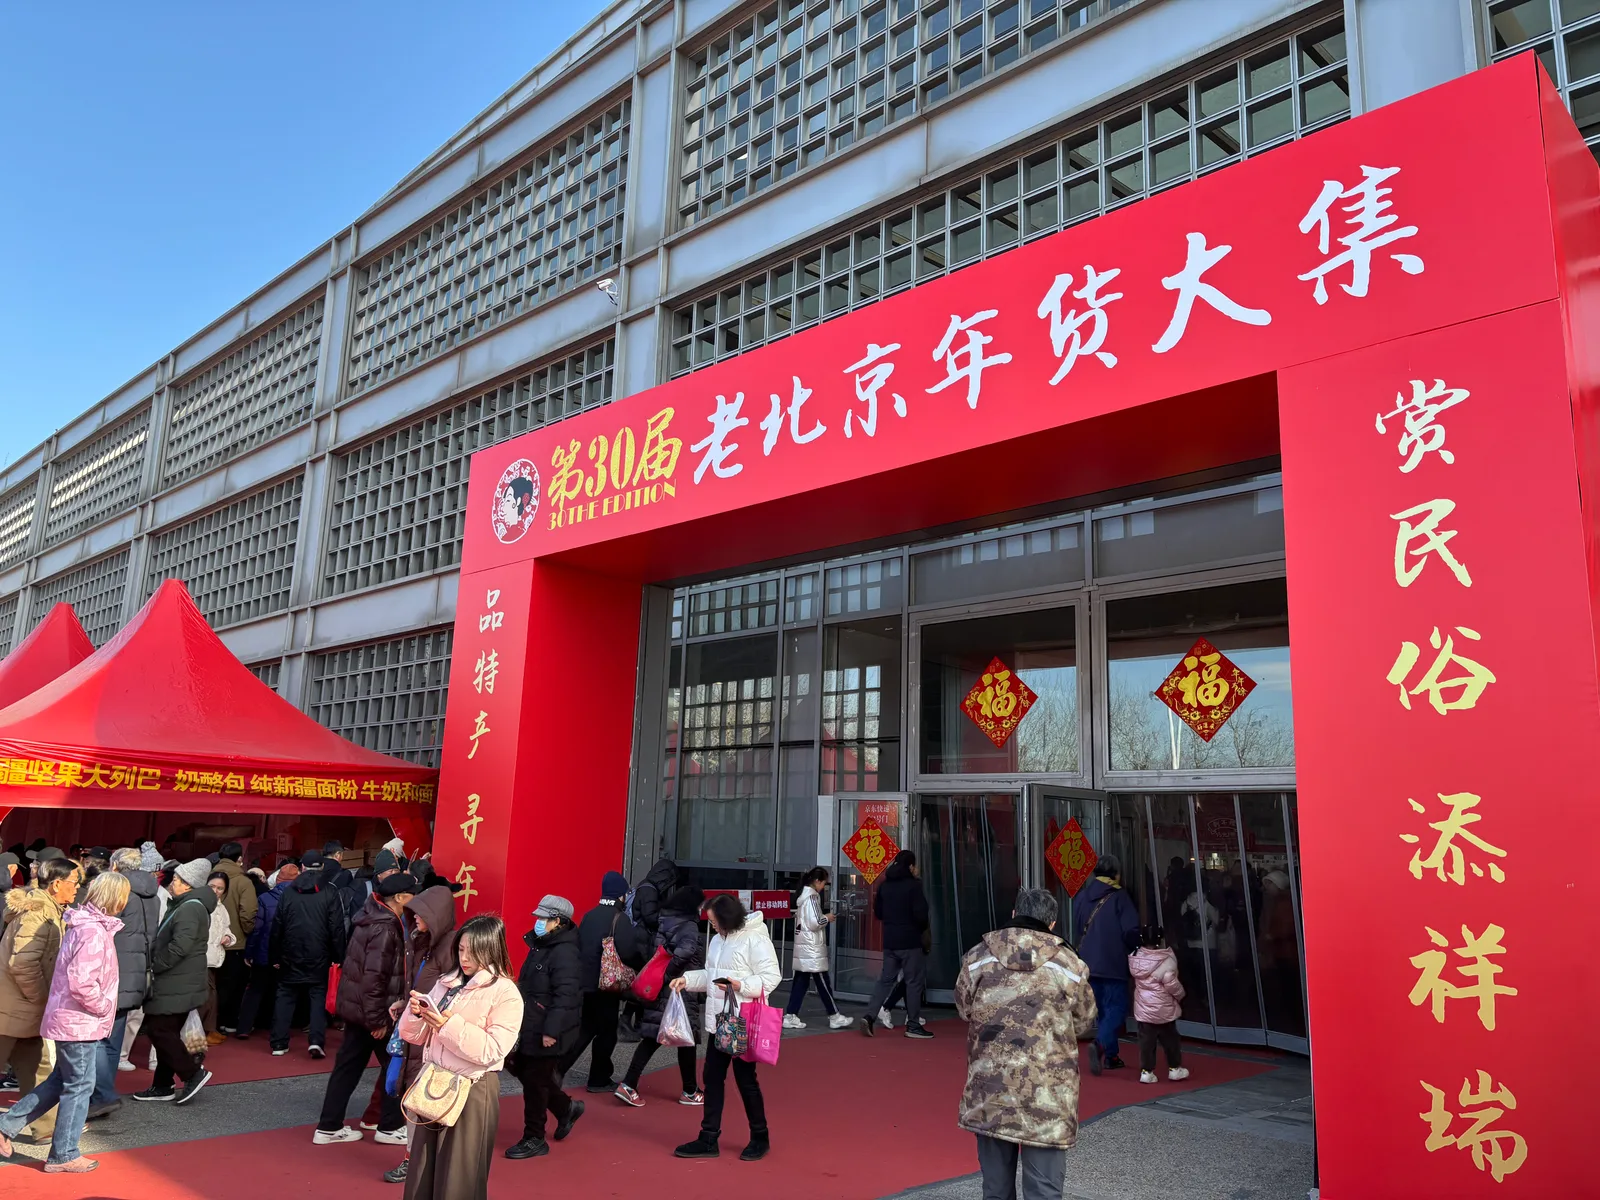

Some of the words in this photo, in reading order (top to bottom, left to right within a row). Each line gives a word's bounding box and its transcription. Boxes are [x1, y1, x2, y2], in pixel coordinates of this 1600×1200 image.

[548, 407, 682, 509] 第30届
[689, 165, 1425, 484] 老北京年货大集
[602, 478, 677, 516] EDITION
[1375, 379, 1496, 715] 赏民俗
[468, 589, 504, 759] 品特产
[977, 670, 1017, 718] 福
[1178, 652, 1229, 708] 福
[173, 769, 245, 794] 奶酪包
[250, 774, 359, 800] 纯新疆面粉
[453, 794, 484, 913] 寻年
[855, 829, 885, 864] 福
[1059, 830, 1085, 870] 福
[1399, 792, 1528, 1183] 添祥瑞
